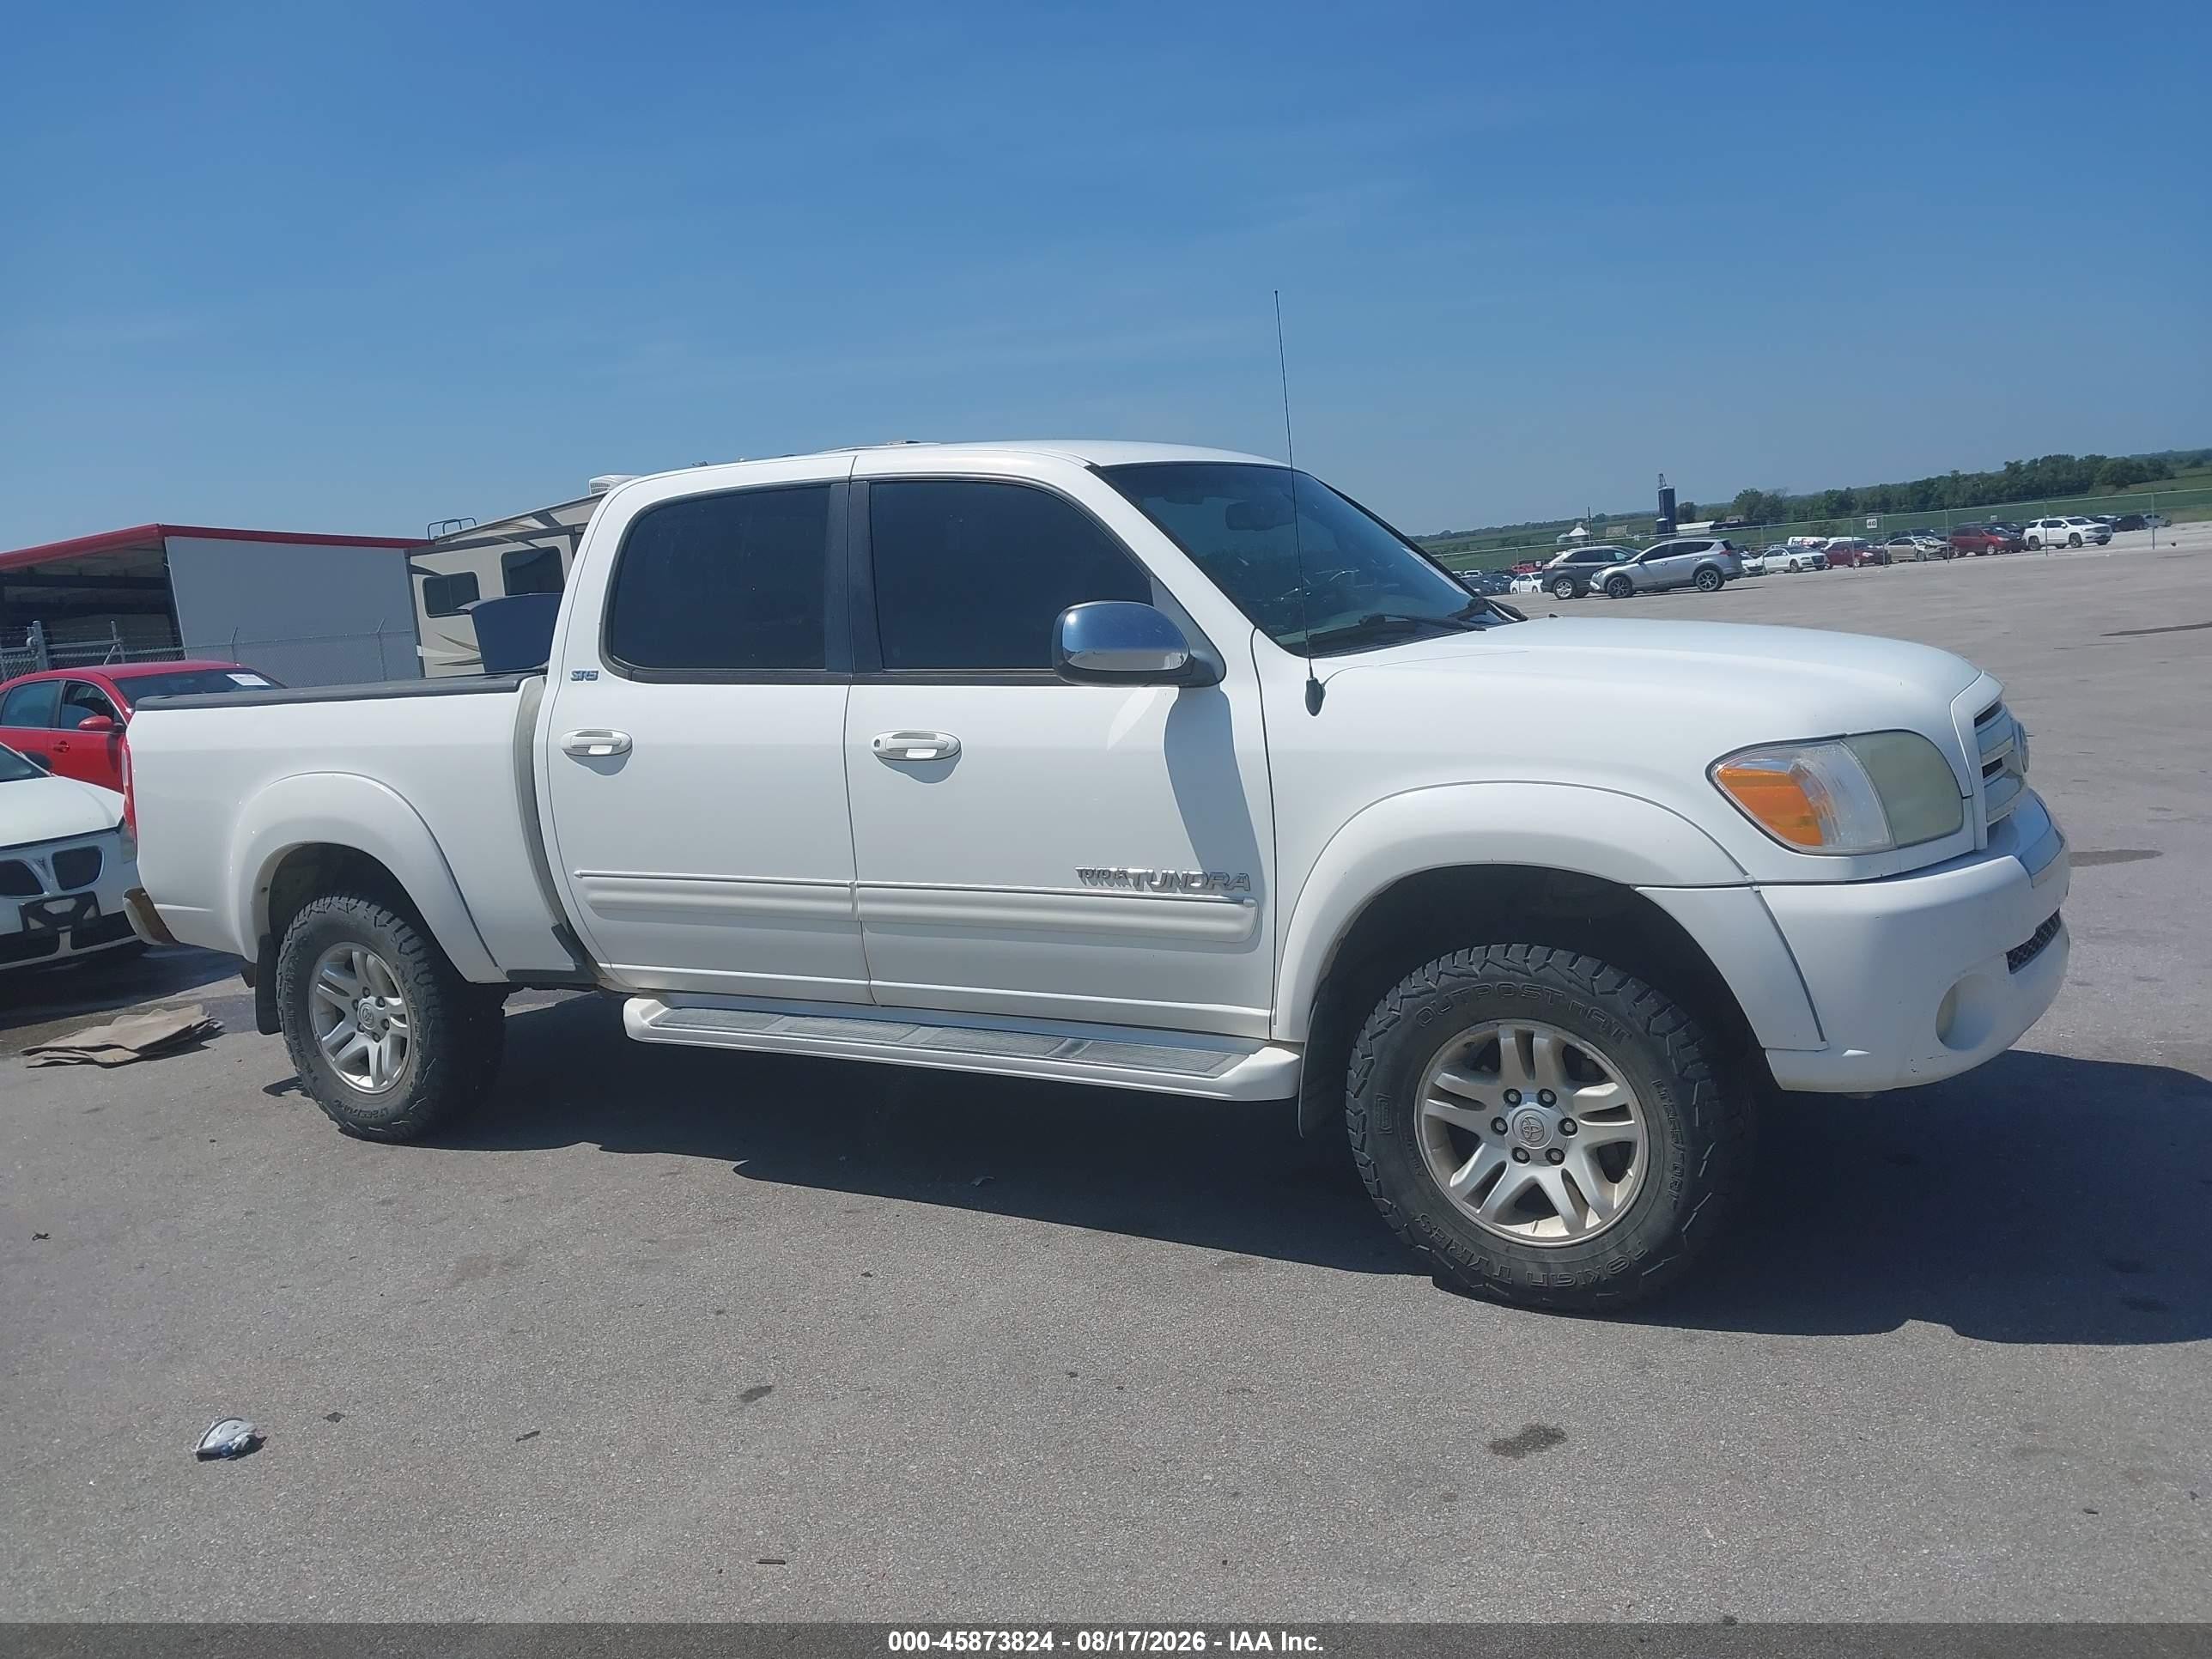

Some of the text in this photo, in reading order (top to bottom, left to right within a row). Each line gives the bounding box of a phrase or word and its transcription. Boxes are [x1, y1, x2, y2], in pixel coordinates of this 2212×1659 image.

[570, 670, 599, 682] SR5
[1129, 867, 1251, 892] TUNDRA
[1416, 981, 1565, 1027] OUTPOST
[1414, 1212, 1513, 1285] TYRES
